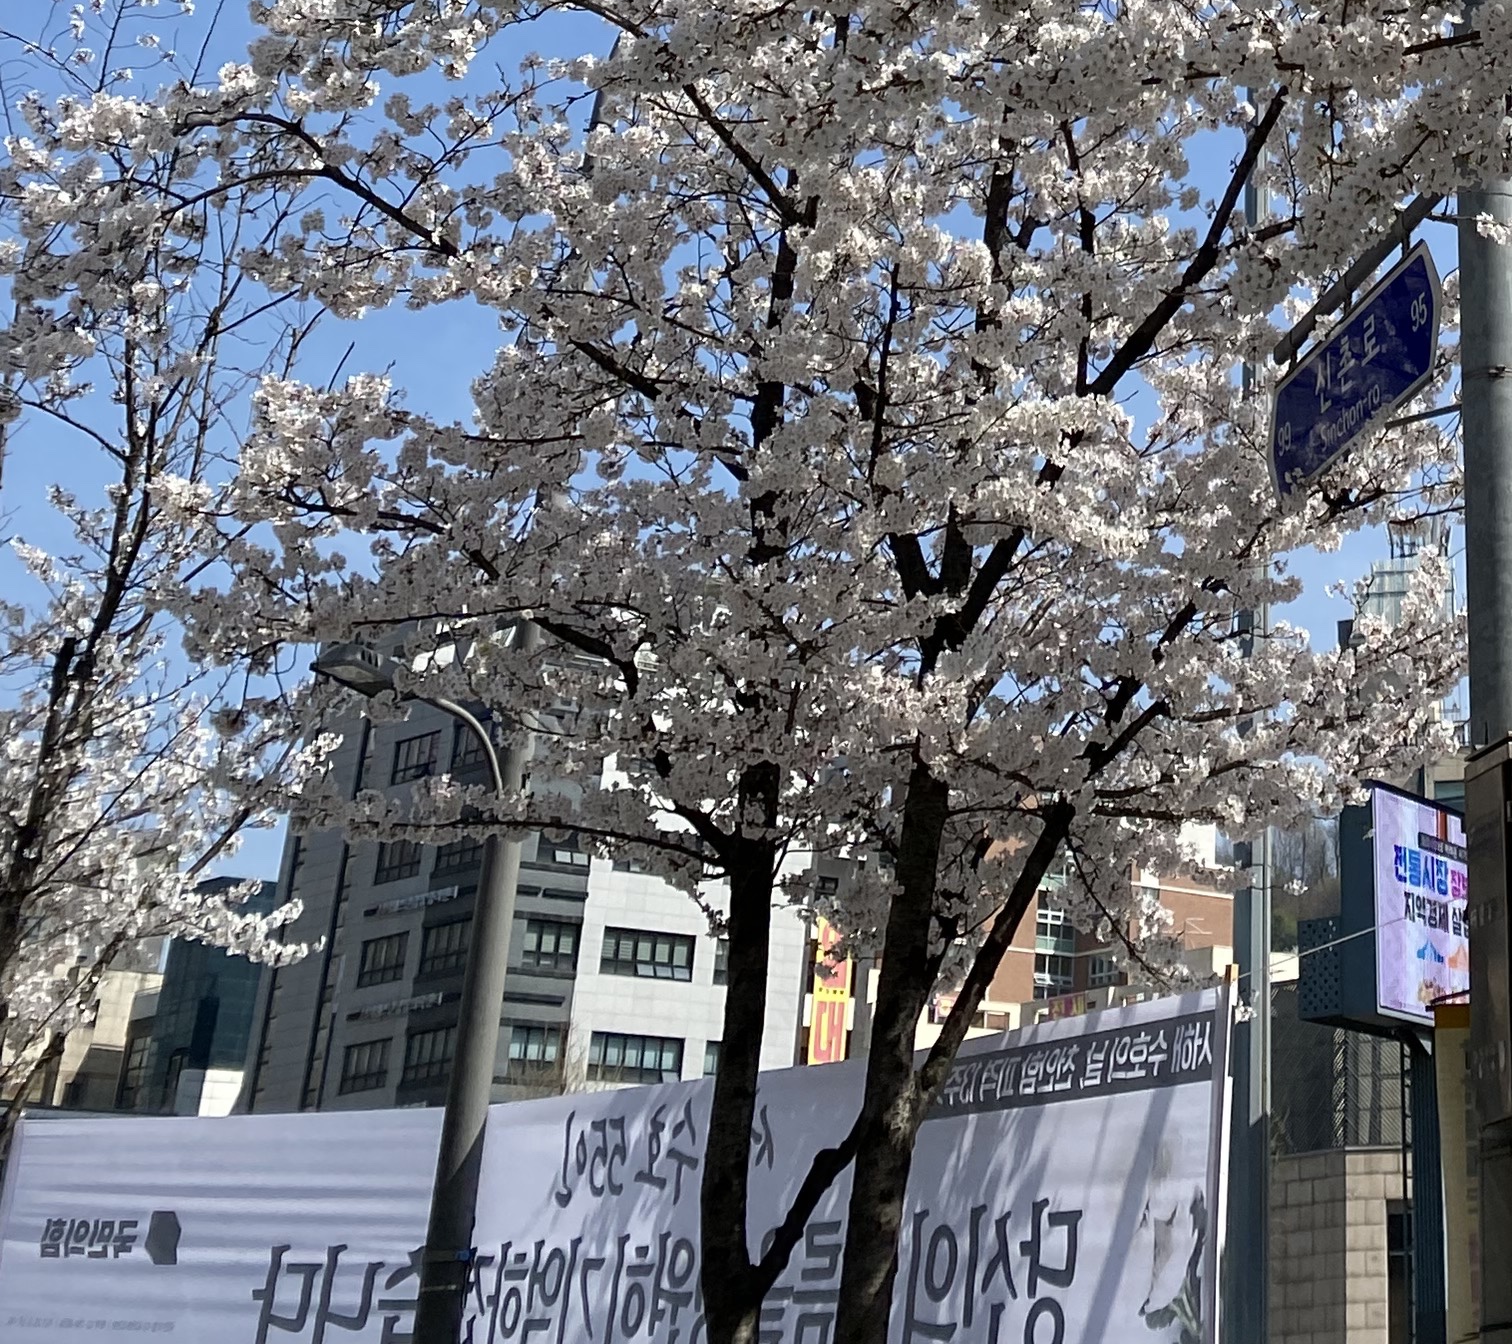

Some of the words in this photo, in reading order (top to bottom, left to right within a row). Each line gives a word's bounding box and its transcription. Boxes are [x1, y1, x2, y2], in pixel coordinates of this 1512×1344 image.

[1410, 292, 1427, 332] 95
[1315, 314, 1380, 414] 신촌로
[1278, 421, 1292, 457] 99
[1320, 384, 1380, 451] Sinchon-ro
[1393, 844, 1449, 896] 전통시장
[1403, 890, 1450, 934] 지역경제
